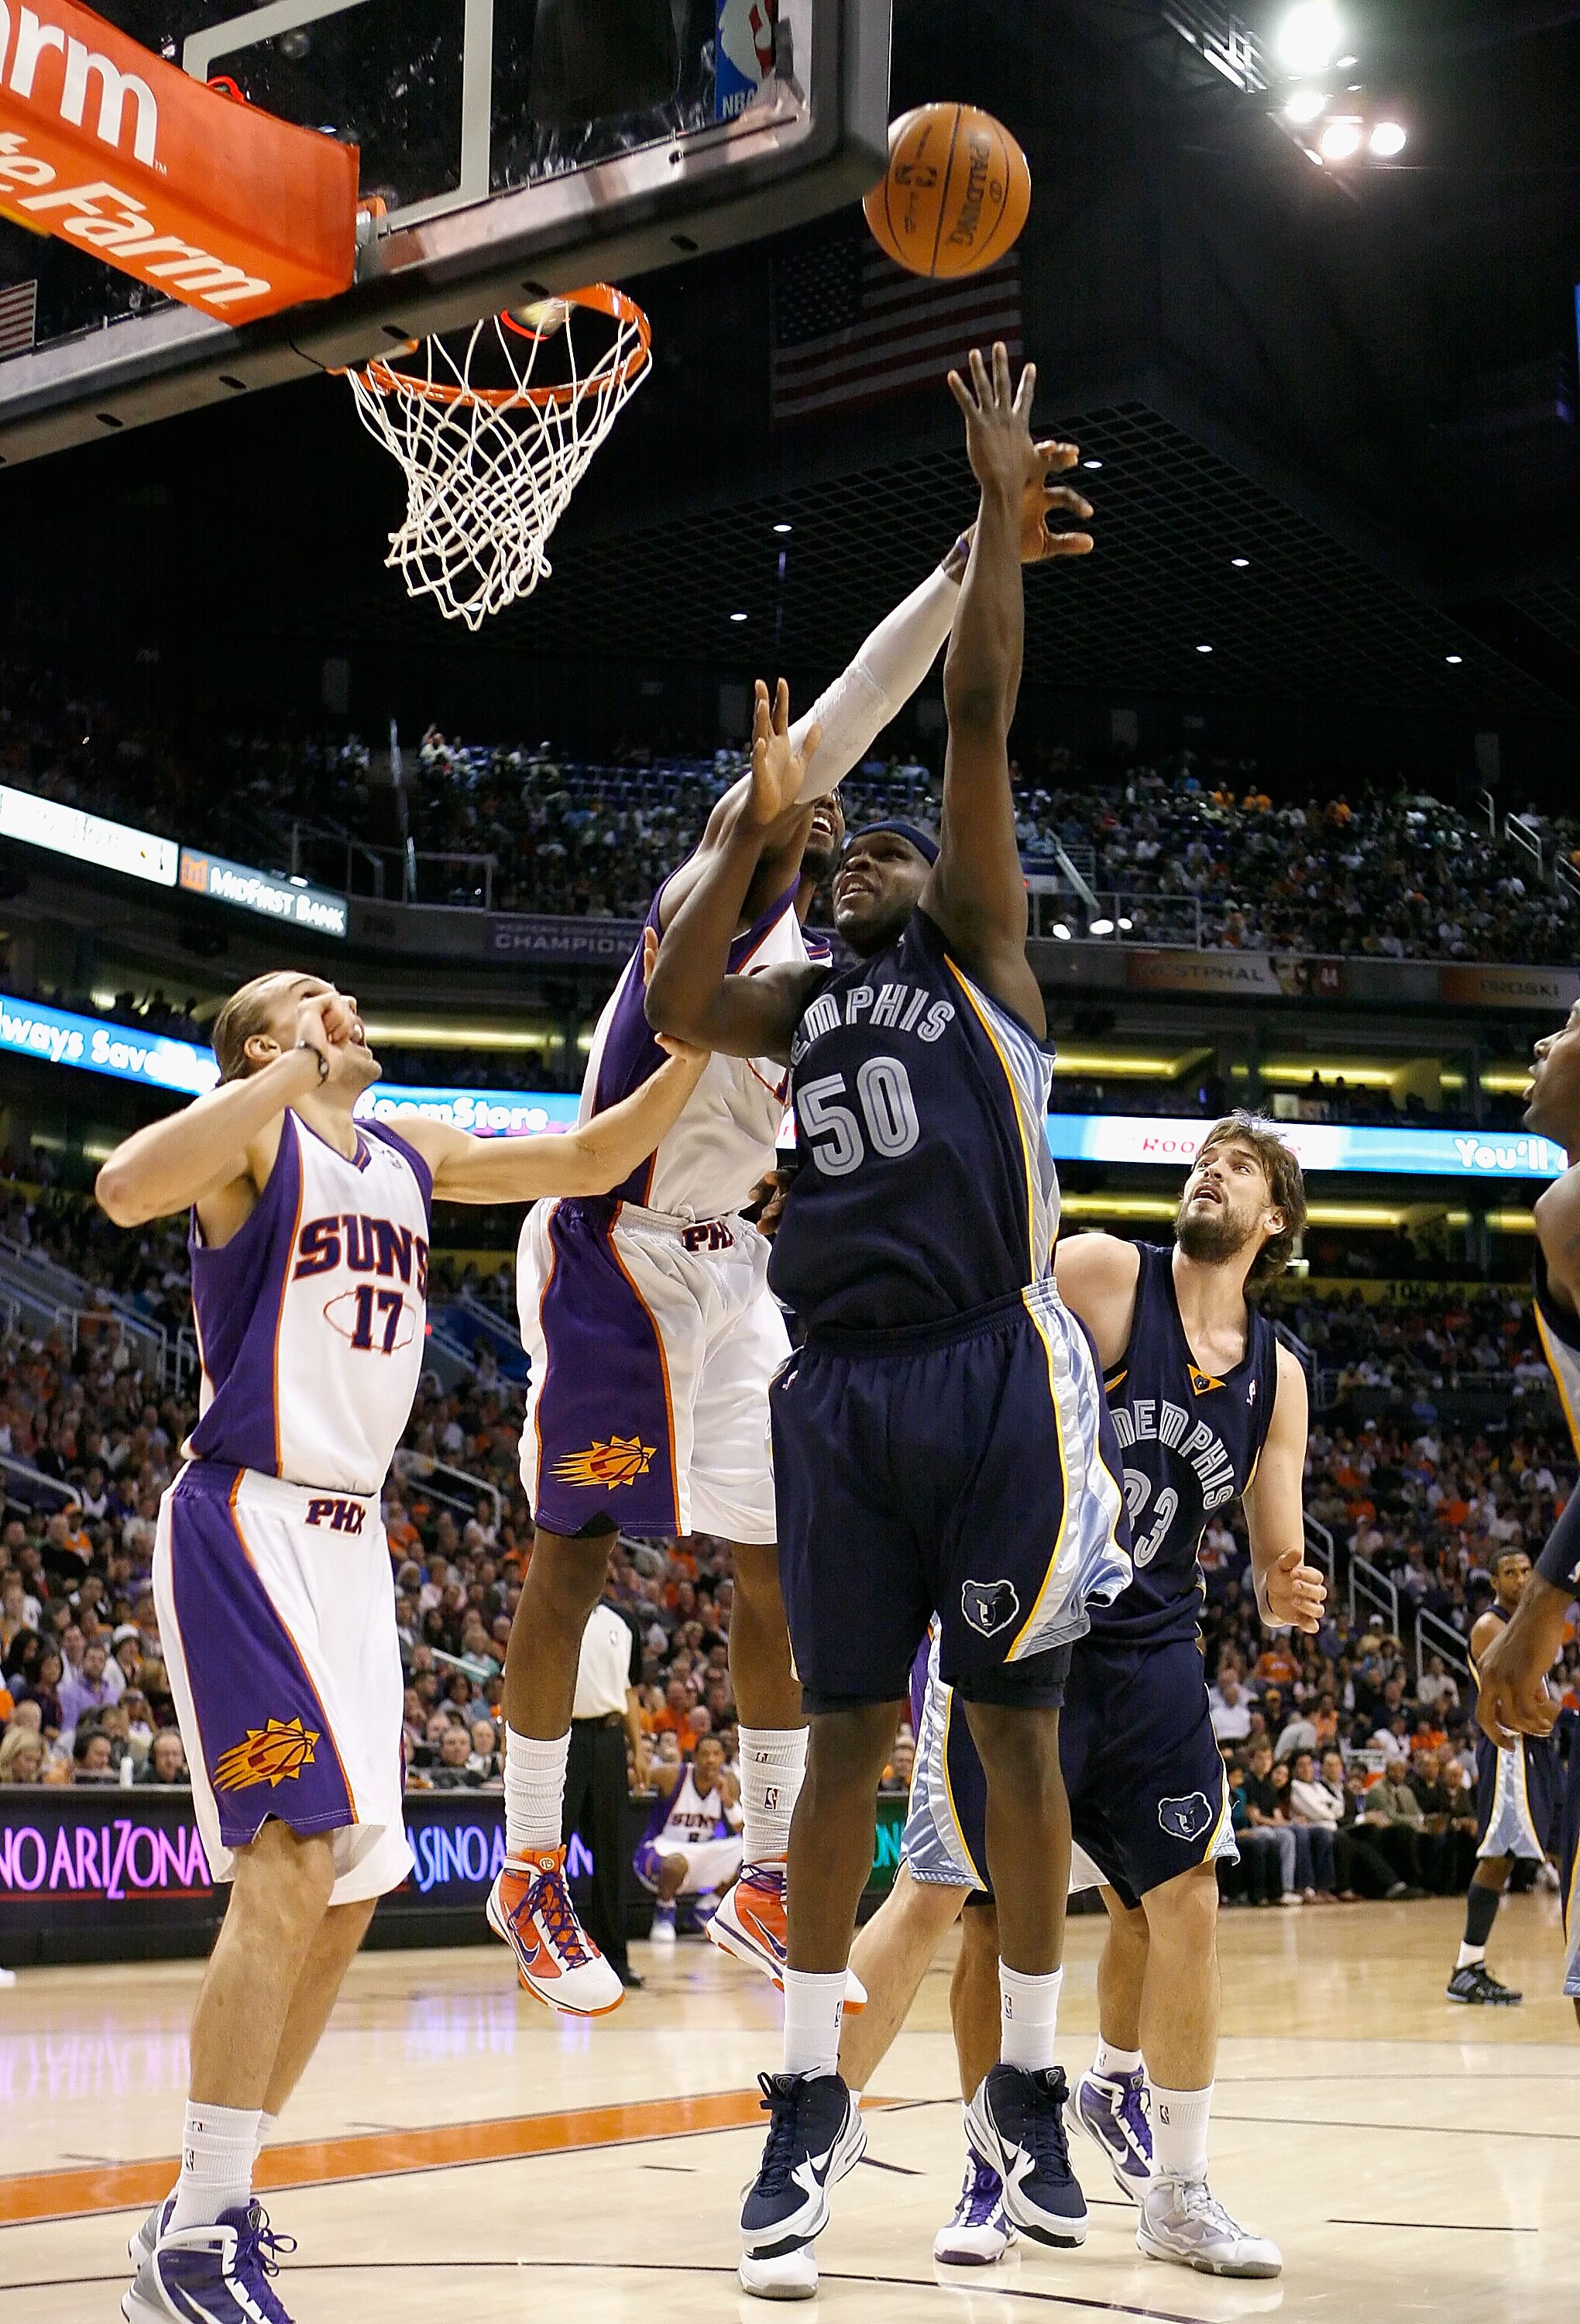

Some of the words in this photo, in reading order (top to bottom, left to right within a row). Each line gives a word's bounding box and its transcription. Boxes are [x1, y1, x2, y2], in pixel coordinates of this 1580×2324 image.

[17, 180, 270, 304] Farm
[352, 1089, 549, 1132] RoomStore
[797, 1057, 919, 1176] 50
[1454, 1137, 1548, 1171] You'll
[292, 1214, 428, 1301] SUNS
[351, 1284, 404, 1355] 17
[305, 1498, 366, 1537] PHX
